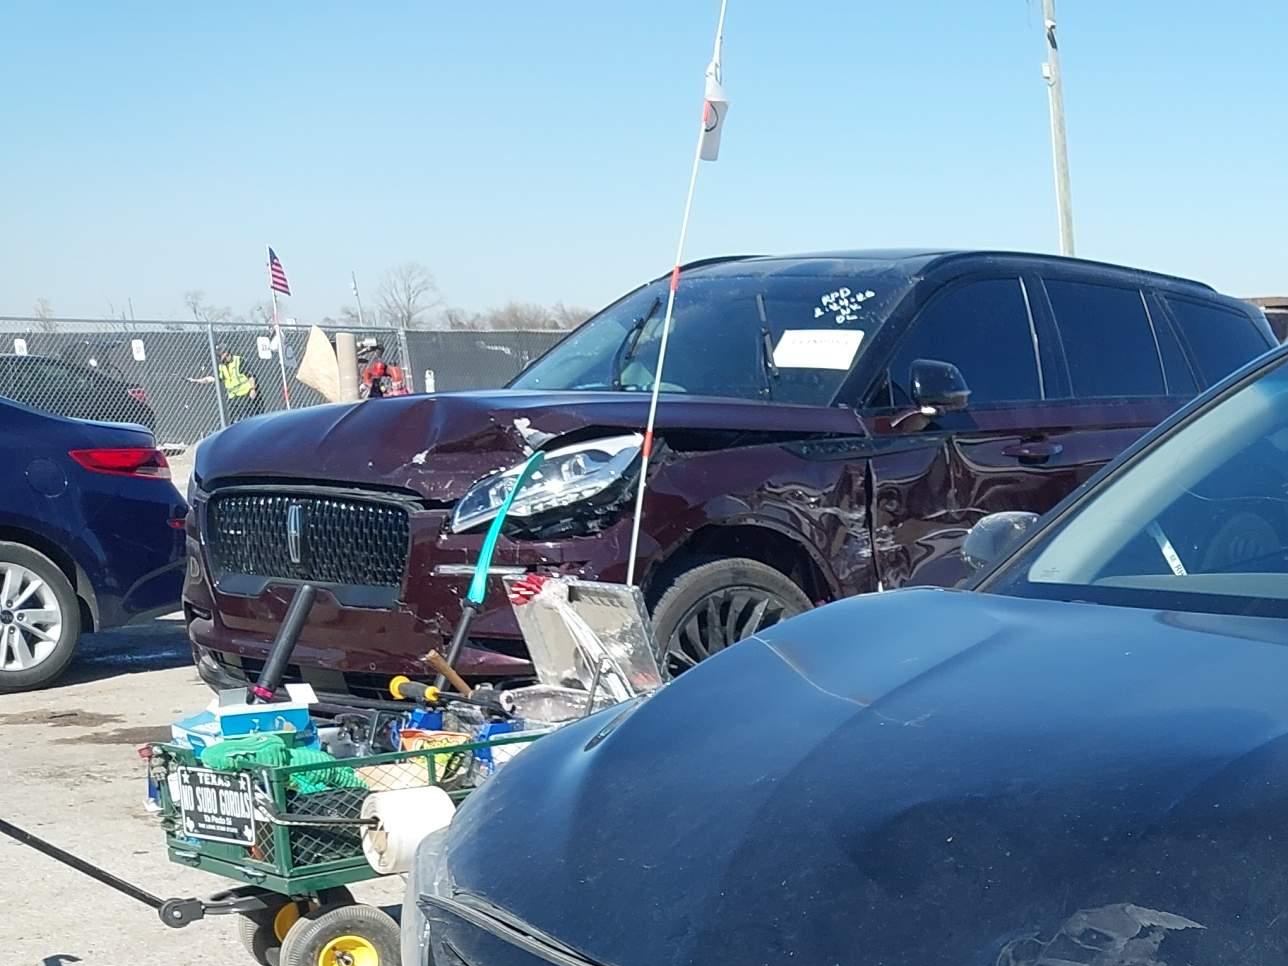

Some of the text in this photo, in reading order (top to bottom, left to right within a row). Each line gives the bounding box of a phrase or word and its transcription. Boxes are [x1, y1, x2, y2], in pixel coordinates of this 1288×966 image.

[197, 772, 231, 788] TEXAS
[181, 784, 251, 819] NO SUBO GORDAS
